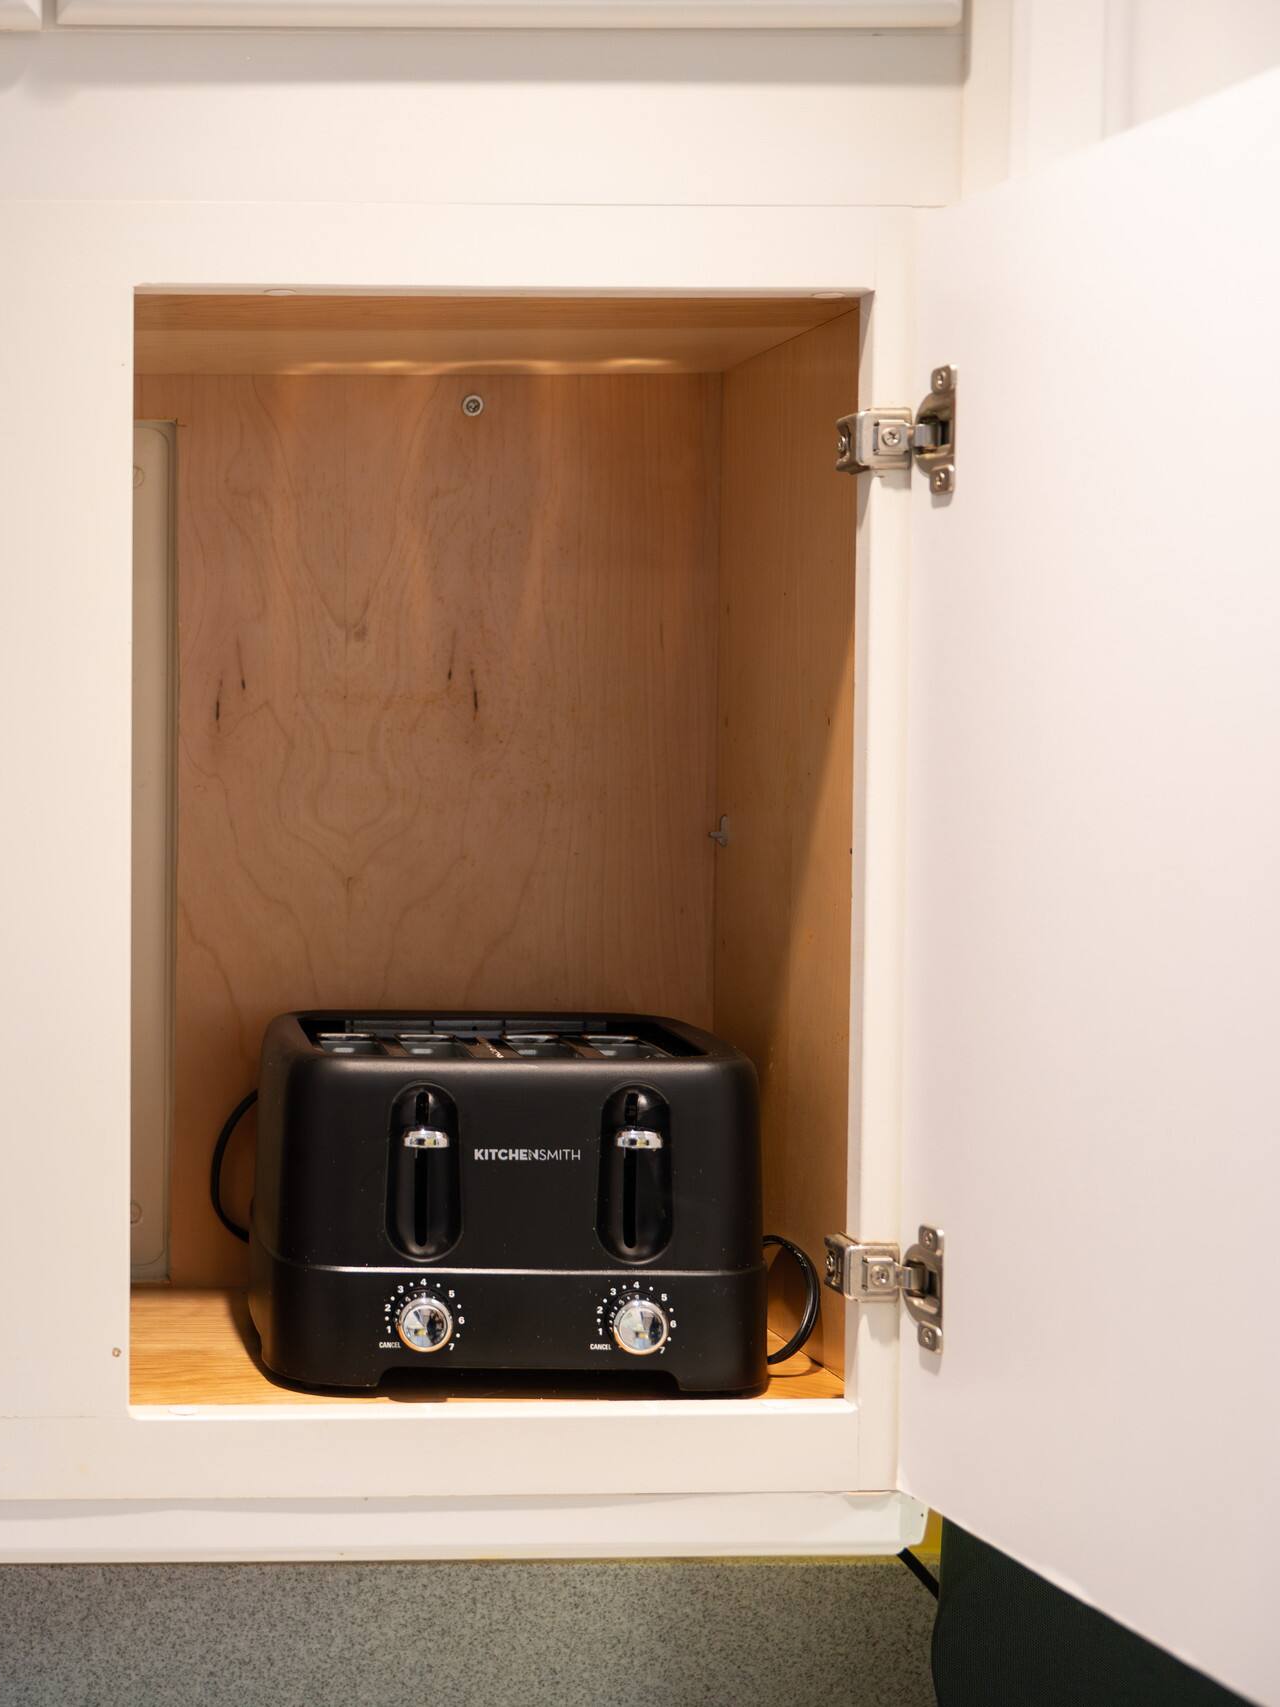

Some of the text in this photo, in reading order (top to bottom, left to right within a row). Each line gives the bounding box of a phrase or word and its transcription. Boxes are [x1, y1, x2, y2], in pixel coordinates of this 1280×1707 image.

[473, 1148, 581, 1161] KITCHENSMITH
[420, 1278, 427, 1286] 4
[633, 1281, 640, 1289] 4
[397, 1285, 404, 1293] 3
[610, 1287, 617, 1296] 3
[448, 1289, 455, 1298] 5
[661, 1293, 668, 1301] 5
[384, 1304, 391, 1312] 2
[596, 1306, 604, 1314] 2
[458, 1316, 465, 1324] 6
[670, 1320, 677, 1328] 6
[386, 1325, 391, 1334] 1
[598, 1327, 603, 1336] 1
[379, 1341, 401, 1349] CANCEL
[448, 1342, 455, 1351] 7
[589, 1343, 612, 1351] CANCEL
[659, 1346, 666, 1354] 7
